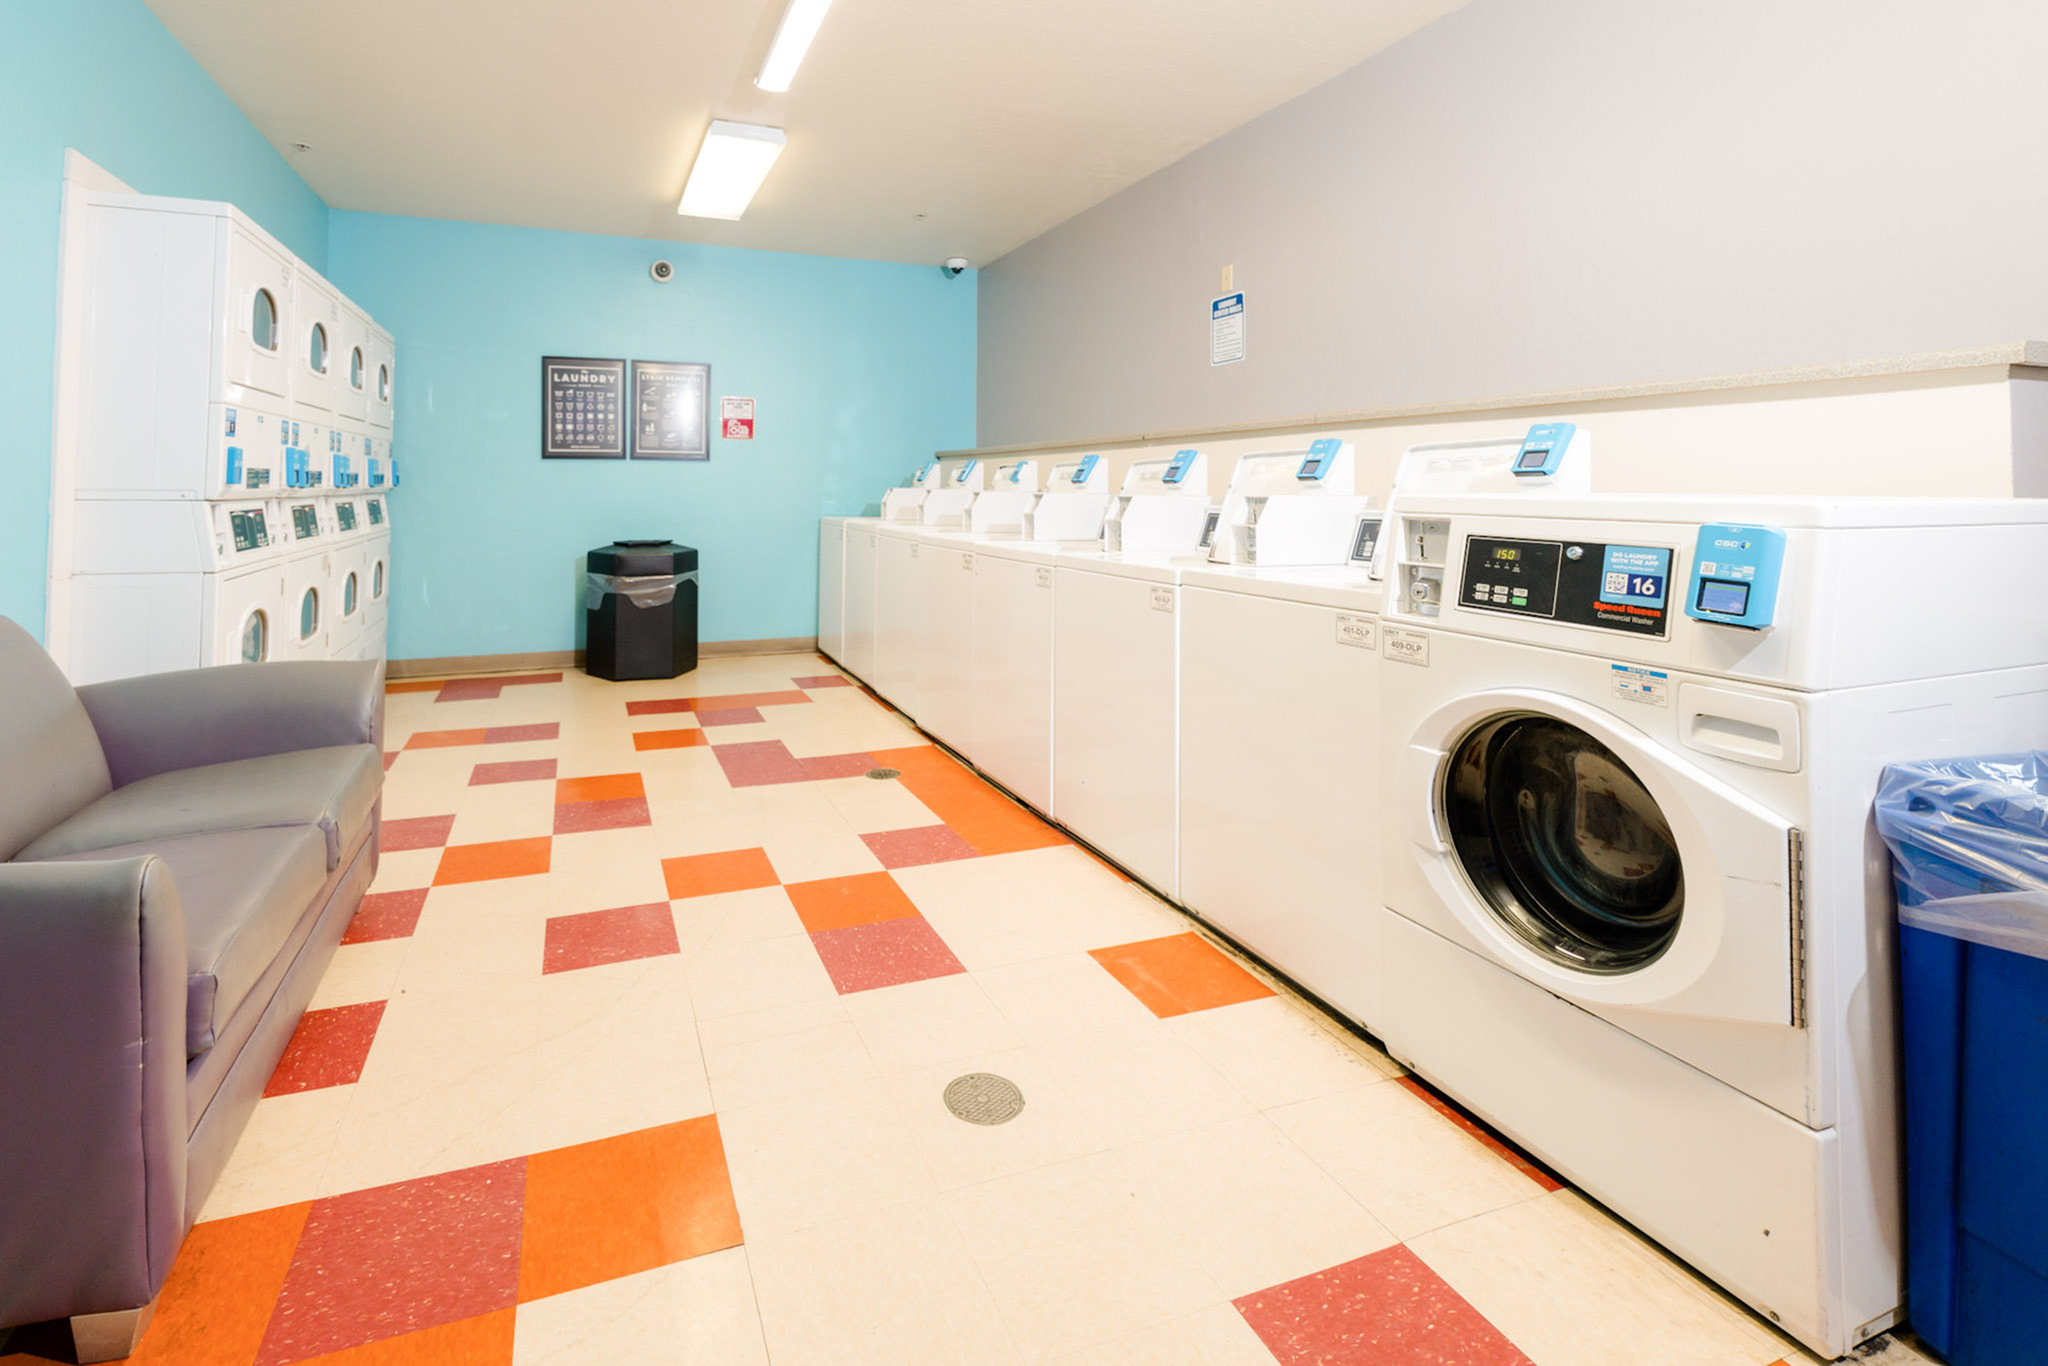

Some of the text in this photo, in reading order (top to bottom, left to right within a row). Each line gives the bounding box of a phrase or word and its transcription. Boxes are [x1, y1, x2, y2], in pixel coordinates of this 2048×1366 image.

[554, 373, 616, 385] LAUNDRY
[1714, 539, 1739, 548] CSC
[1496, 549, 1516, 560] 150
[1624, 553, 1657, 561] LAUNDRY
[1632, 577, 1656, 596] 16
[1593, 601, 1662, 618] Speed Queen
[1597, 611, 1654, 625] Commercial Washer
